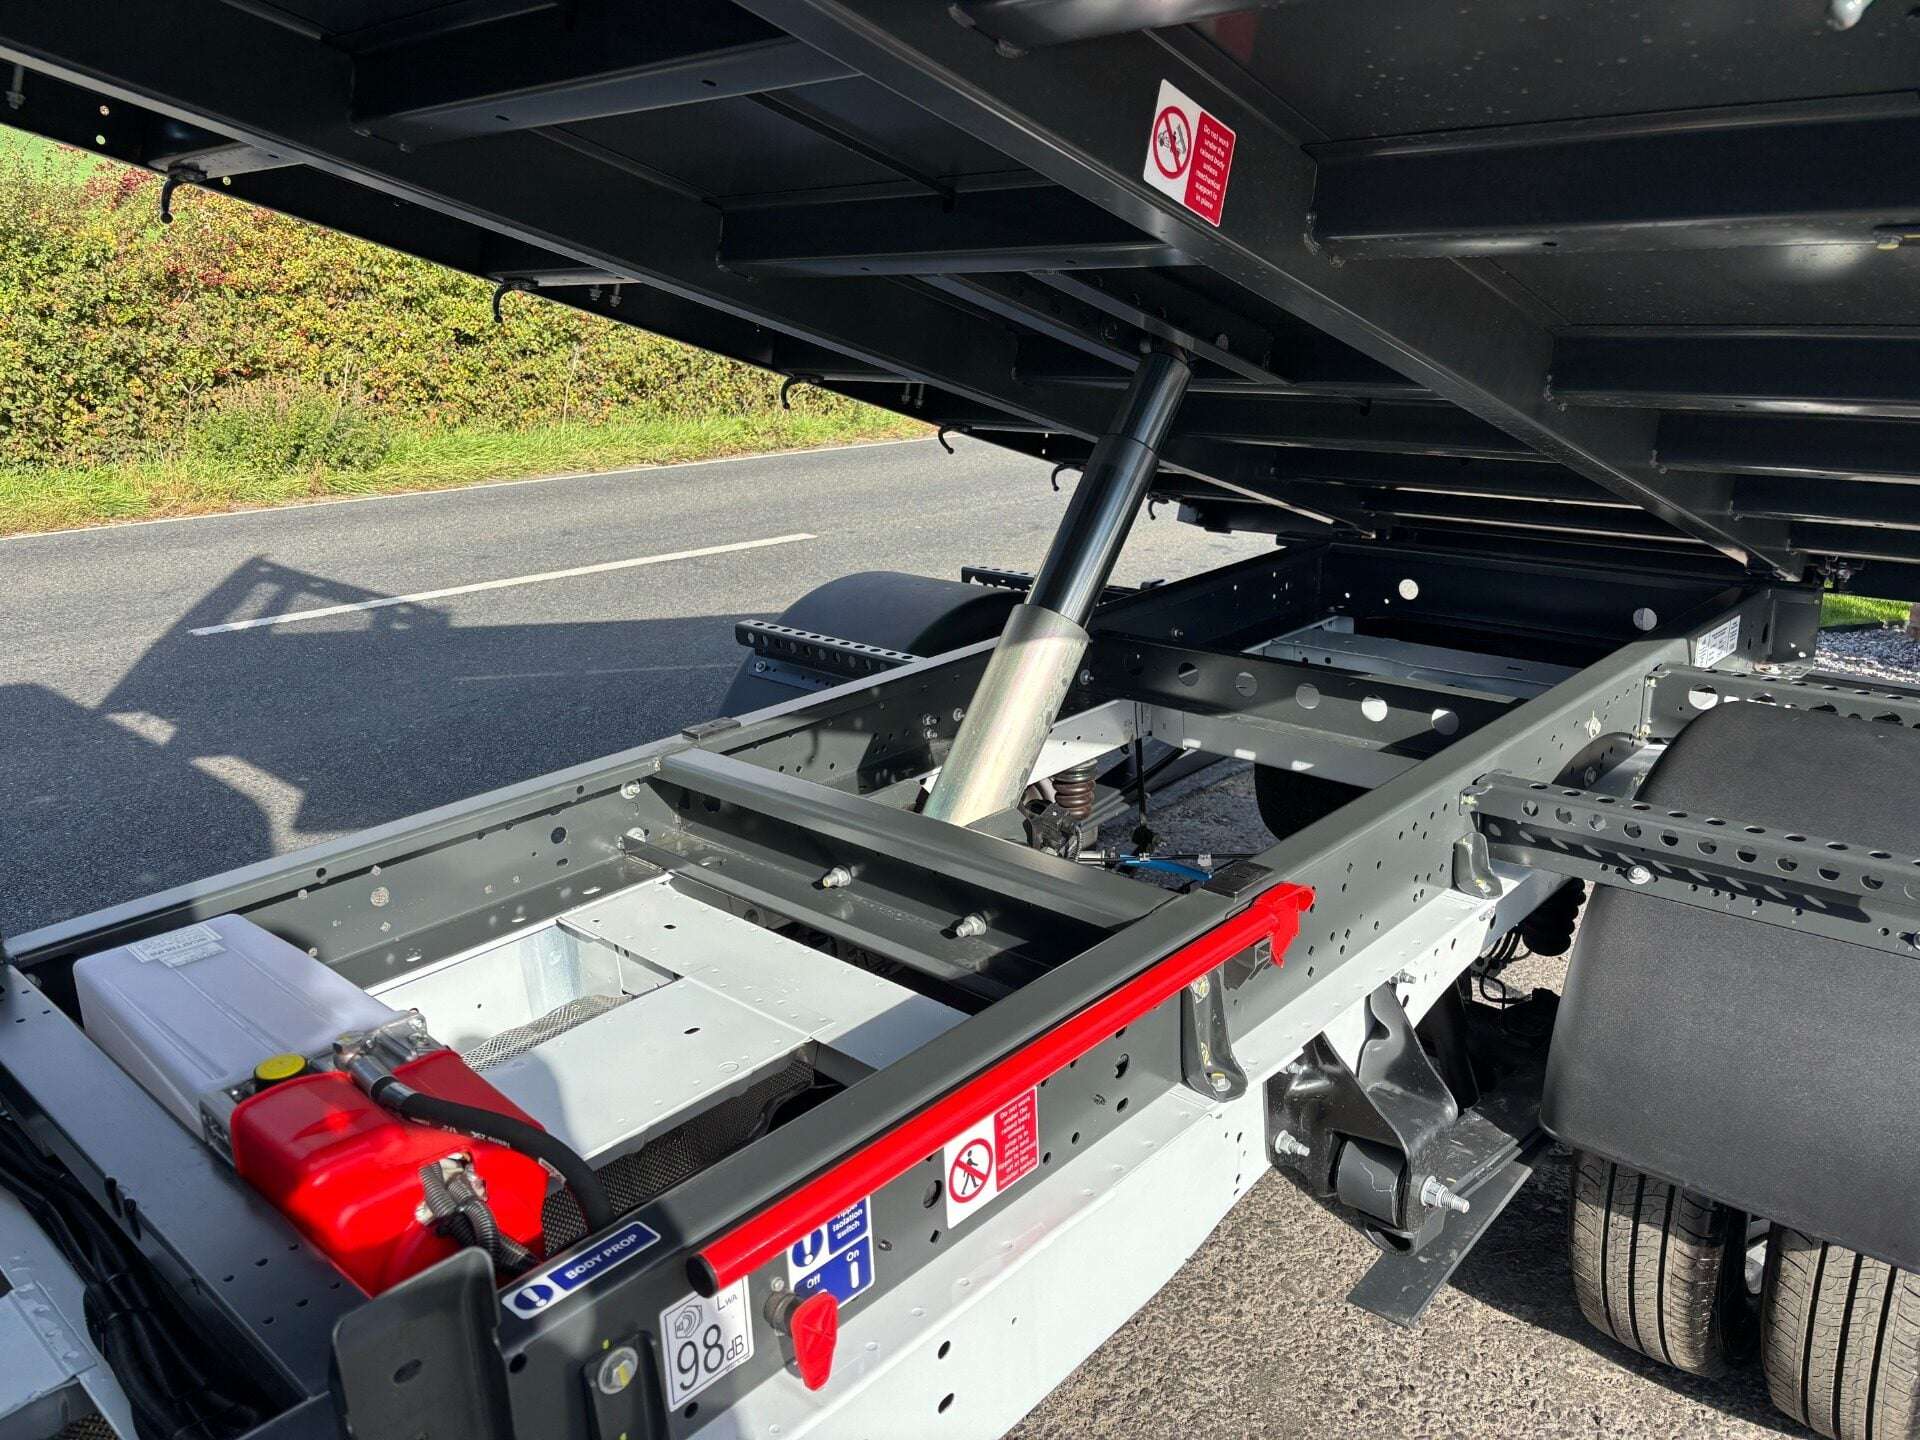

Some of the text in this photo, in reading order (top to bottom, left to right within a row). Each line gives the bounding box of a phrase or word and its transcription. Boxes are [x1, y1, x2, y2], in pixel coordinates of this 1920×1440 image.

[1203, 125, 1229, 148] Do not work
[1204, 139, 1218, 152] under
[1200, 147, 1225, 170] raised body
[1203, 163, 1218, 176] unless
[1196, 170, 1221, 190] mechanical
[1195, 182, 1212, 198] support
[1200, 198, 1214, 210] place
[836, 1220, 860, 1240] switch
[564, 1234, 638, 1280] BODY PROP
[846, 1250, 860, 1262] On
[806, 1273, 821, 1288] Off
[677, 1324, 744, 1391] 98 dB
